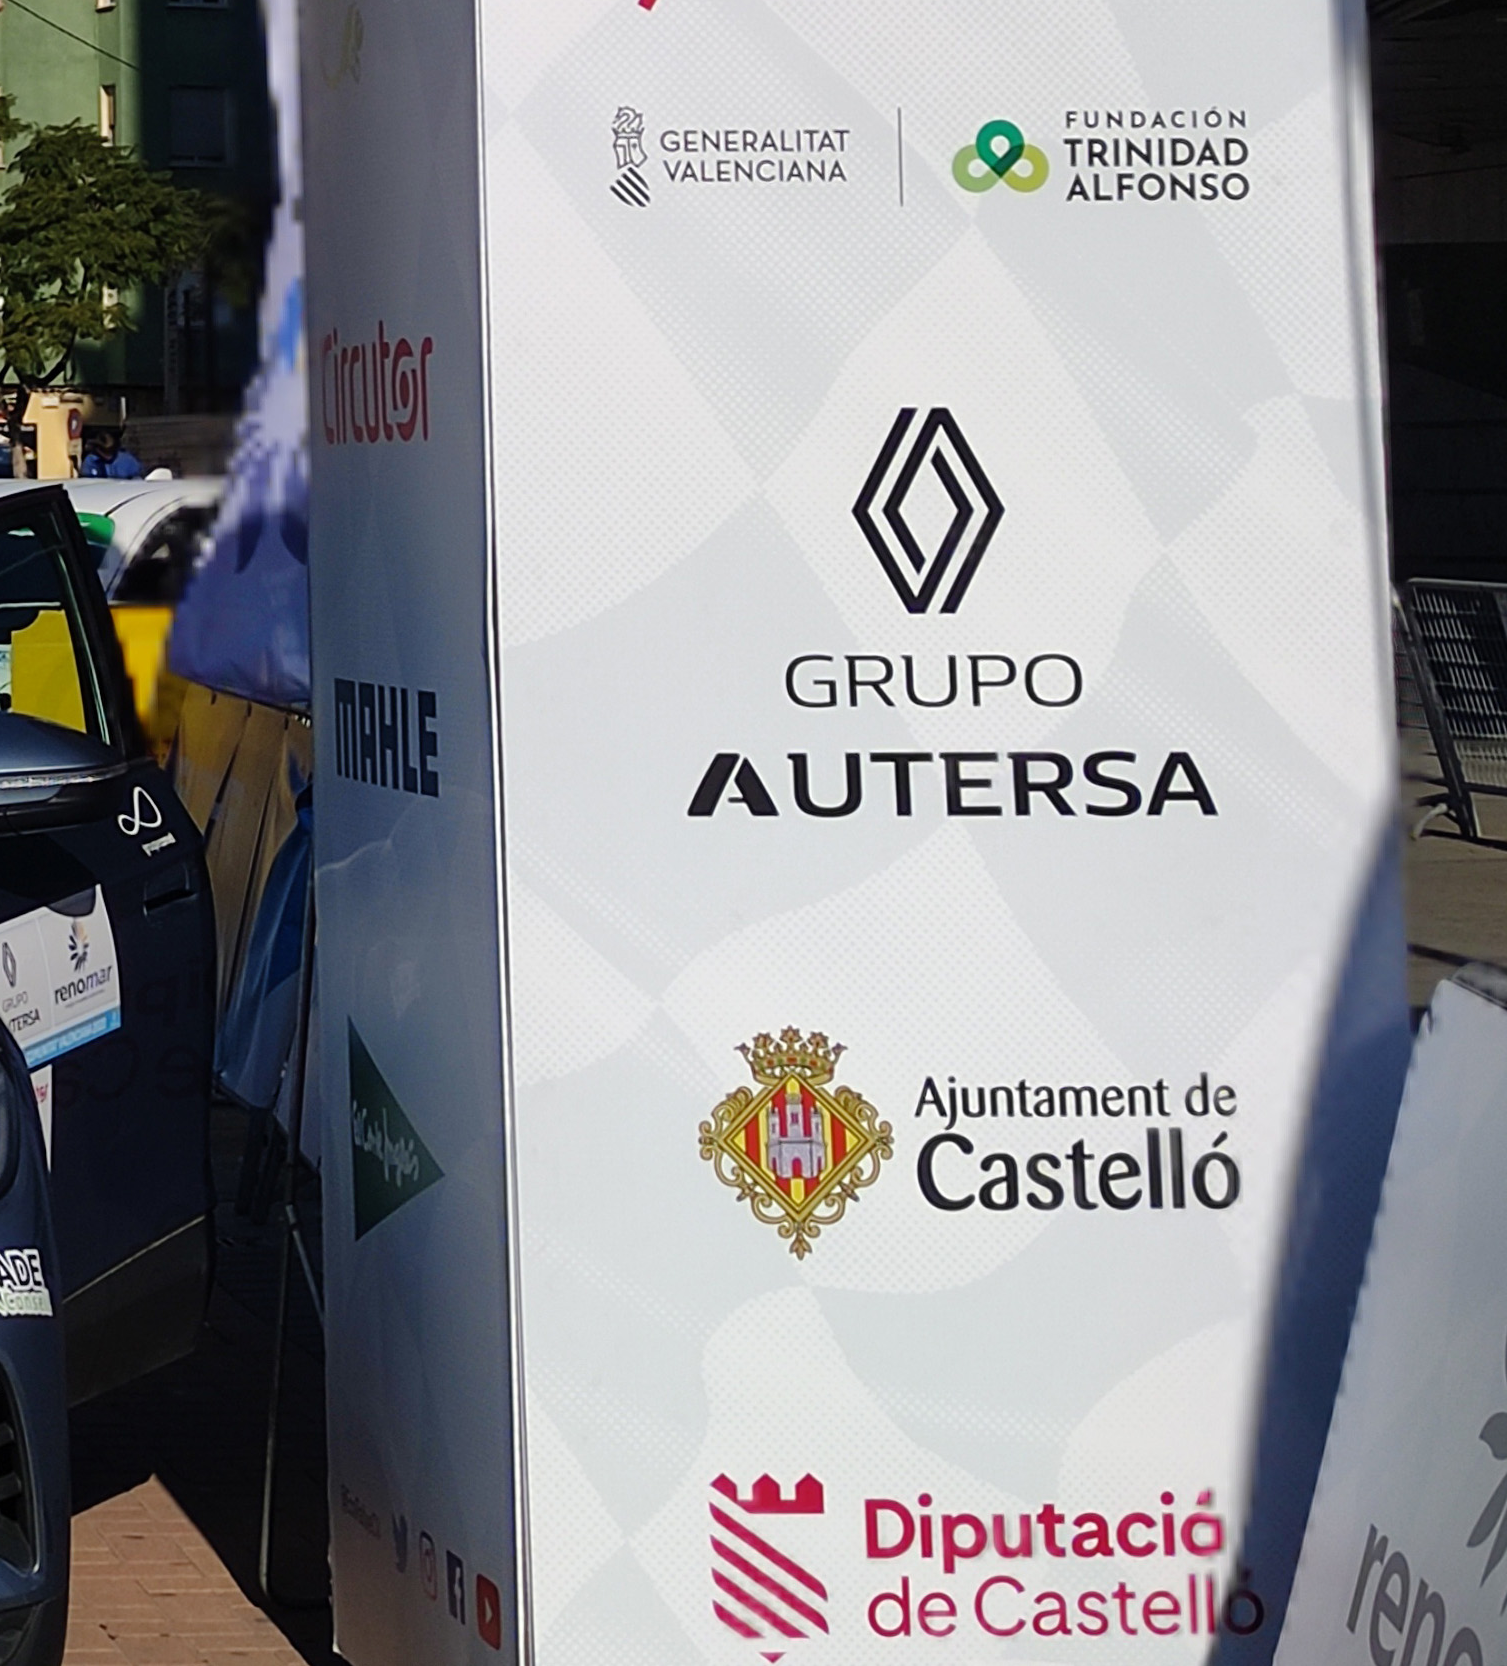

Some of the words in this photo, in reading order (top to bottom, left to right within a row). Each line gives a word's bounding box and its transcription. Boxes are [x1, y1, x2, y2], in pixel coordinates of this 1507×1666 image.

[660, 129, 849, 153] GENERALITAT
[1065, 106, 1248, 129] FUNDACIÓN
[663, 160, 848, 183] VALENCIANA
[1063, 137, 1250, 168] TRINIDAD
[1065, 172, 1251, 203] ALFONSO
[321, 320, 433, 443] Circutor
[786, 653, 1084, 709] GRUPO
[334, 678, 440, 798] MAHLE
[687, 750, 1219, 818] AUTERSA
[2, 991, 28, 1013] GRUPO
[54, 965, 113, 1005] renomar
[9, 1008, 41, 1033] TERSA
[914, 1076, 1170, 1131] Ajuntament
[1185, 1072, 1237, 1118] de
[915, 1127, 1241, 1213] Castelló
[864, 1489, 1224, 1574] Diputació
[866, 1576, 959, 1637] de
[974, 1568, 1265, 1638] Castelló
